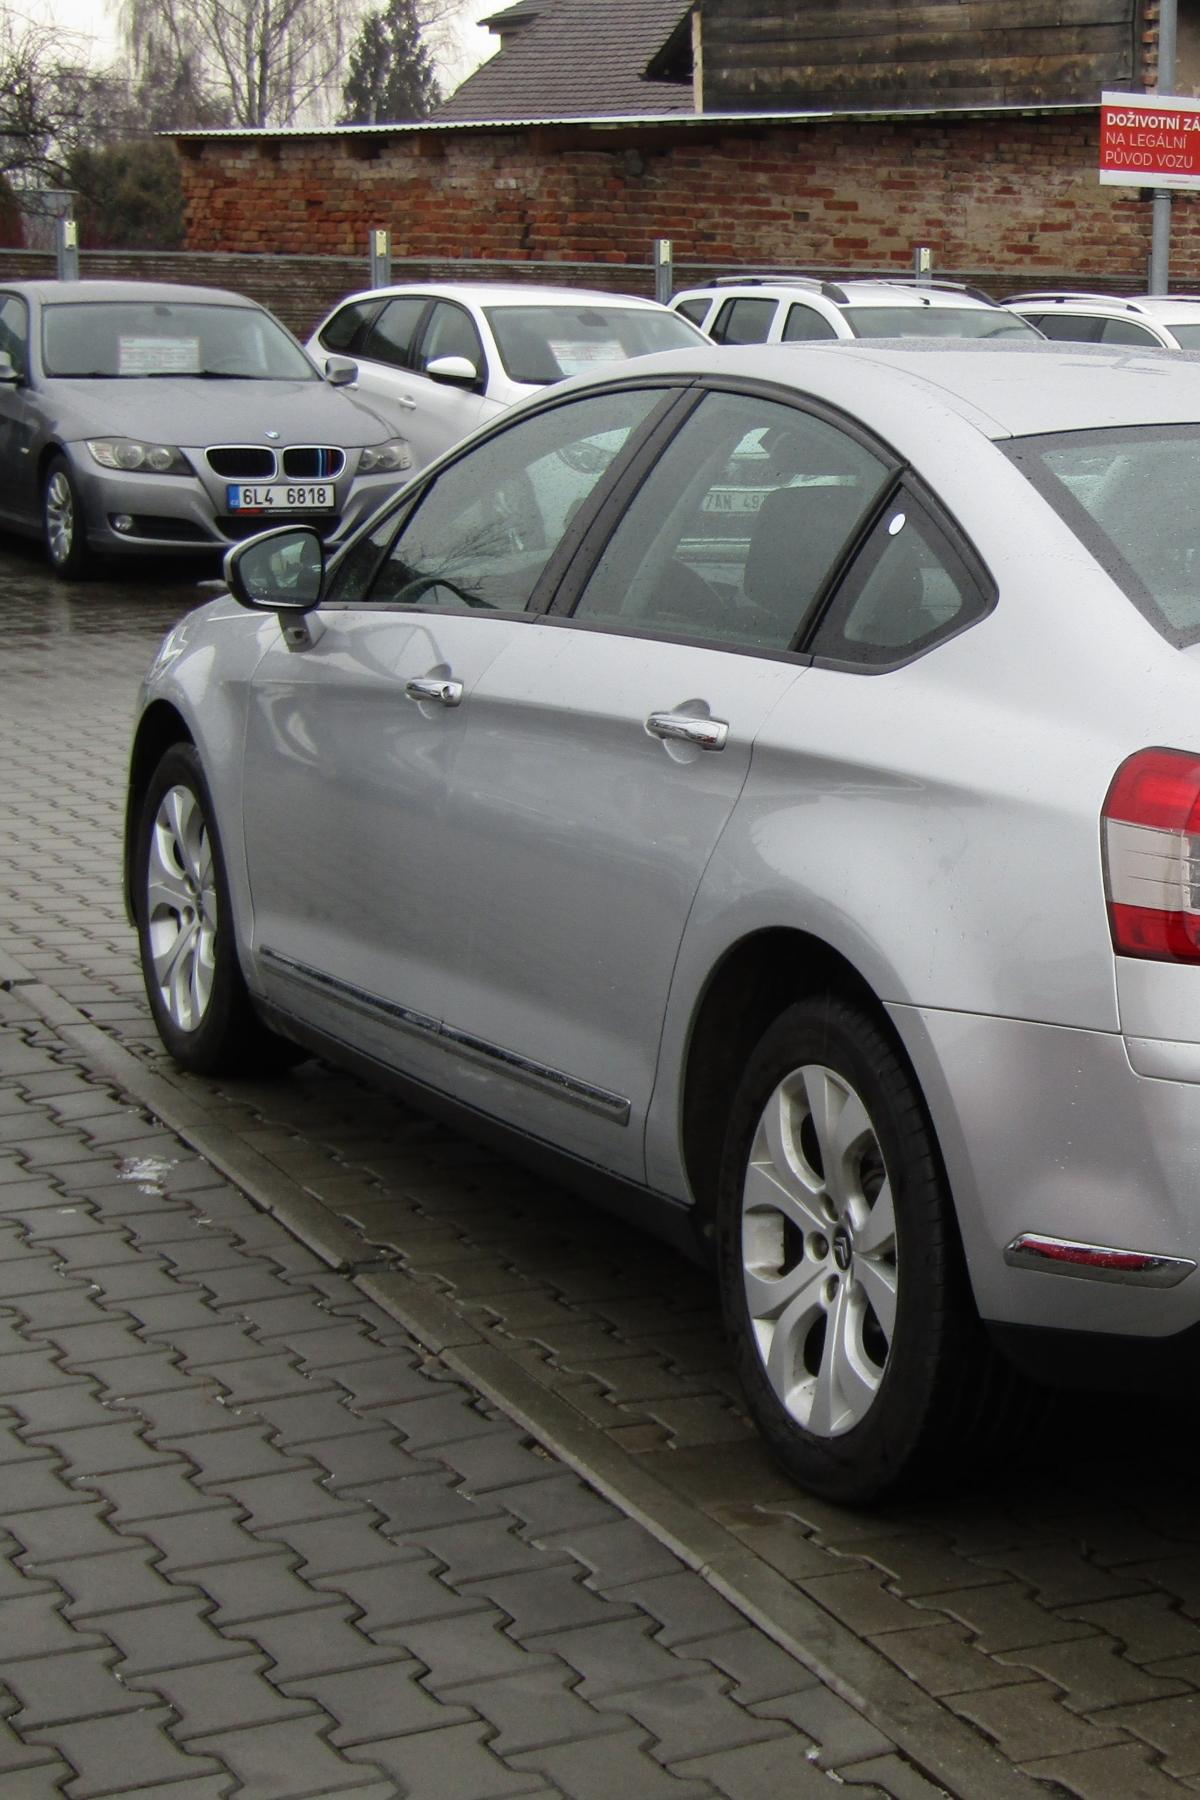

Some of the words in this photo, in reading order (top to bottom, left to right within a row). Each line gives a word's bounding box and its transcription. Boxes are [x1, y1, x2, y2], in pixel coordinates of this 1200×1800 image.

[1106, 111, 1180, 129] DOŽIVOTNÍ
[1105, 132, 1125, 145] NA
[1129, 132, 1188, 149] LEGÁLNÍ
[1105, 148, 1153, 166] PŮVOD
[1156, 153, 1193, 169] VOZU
[243, 488, 274, 505] 6L4
[287, 487, 326, 504] 6818
